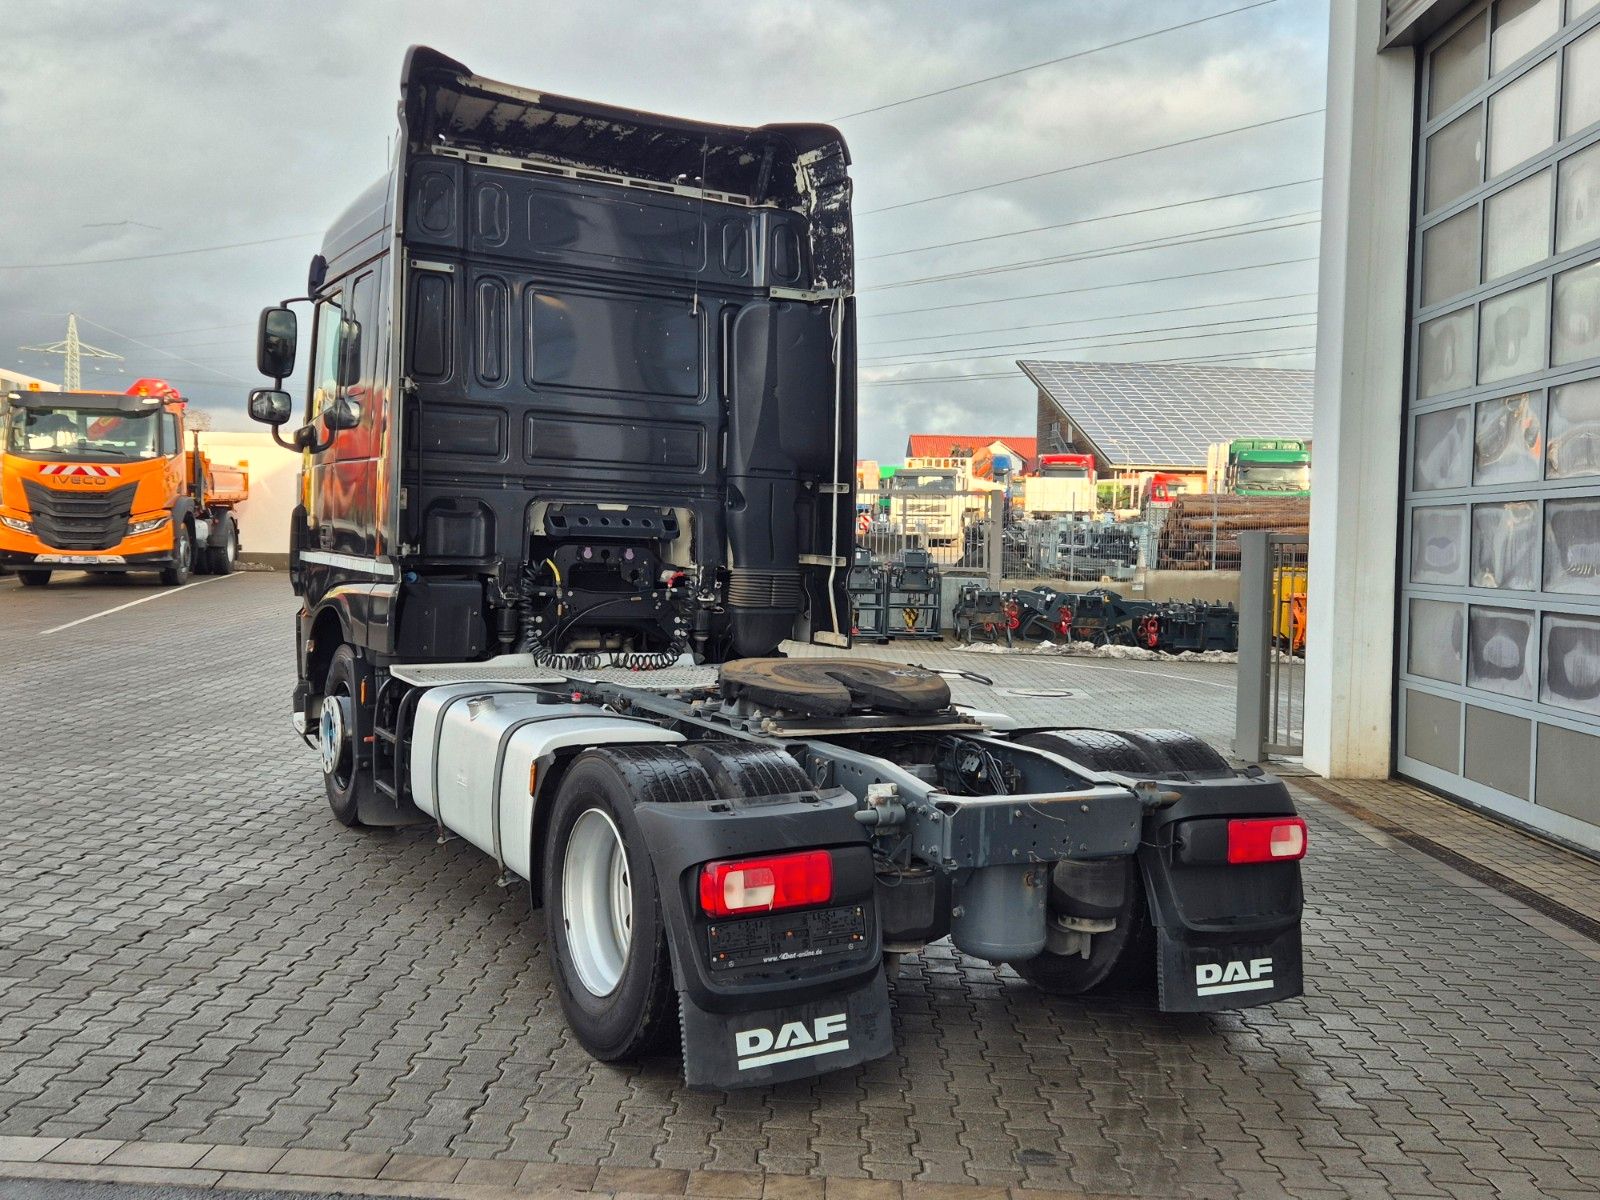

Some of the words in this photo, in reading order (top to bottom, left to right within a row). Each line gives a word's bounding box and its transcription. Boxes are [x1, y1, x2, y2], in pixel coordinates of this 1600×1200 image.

[53, 475, 107, 485] IVECO
[1195, 957, 1273, 986] DAF
[735, 1012, 848, 1057] DAF
